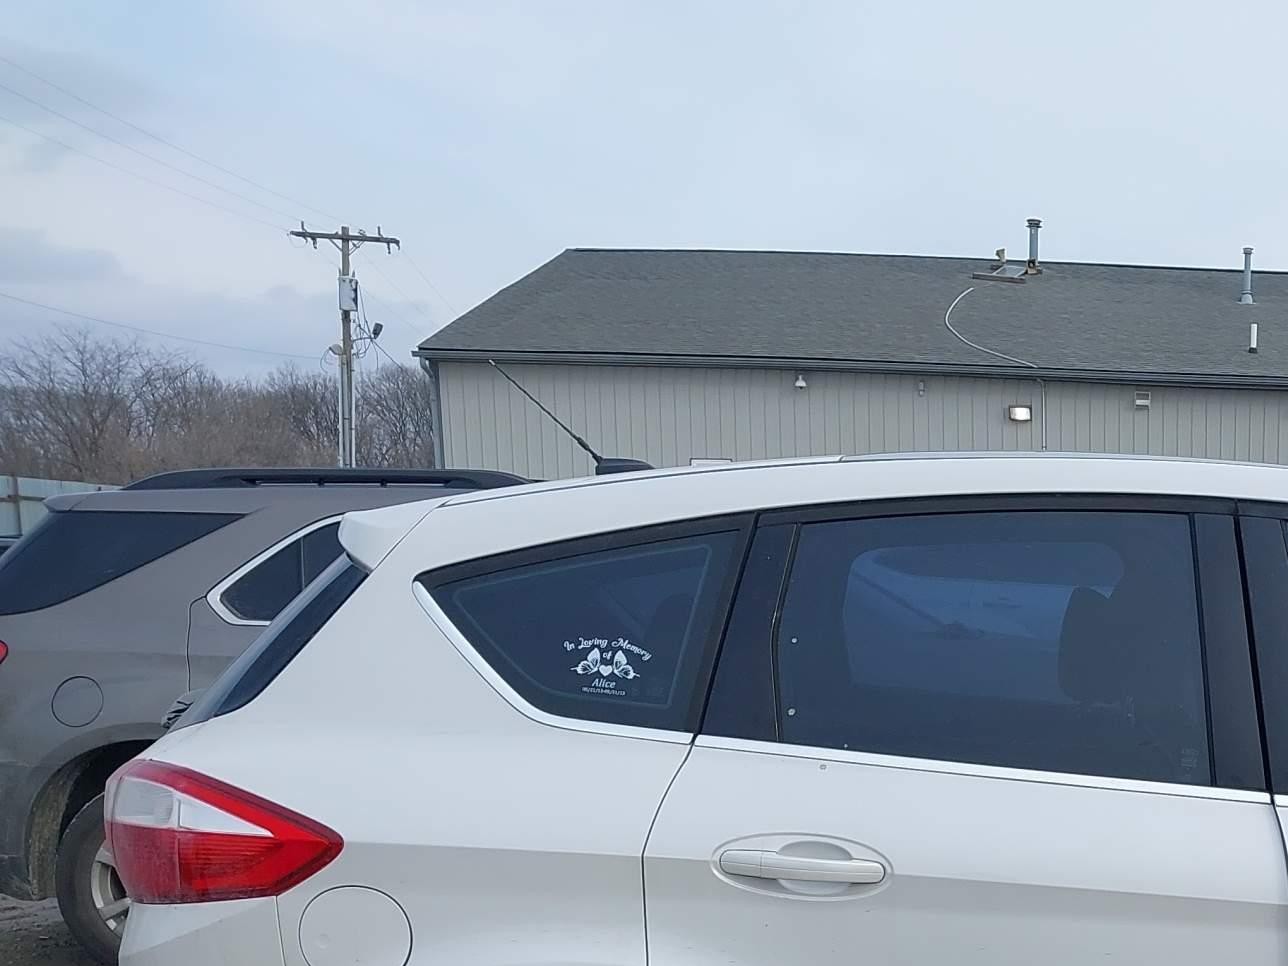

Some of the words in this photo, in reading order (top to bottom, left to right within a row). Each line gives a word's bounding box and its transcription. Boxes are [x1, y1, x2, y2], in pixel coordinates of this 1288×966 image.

[563, 641, 575, 651] In
[578, 637, 608, 649] Loving
[611, 637, 652, 661] Memory
[602, 651, 612, 660] of
[591, 678, 616, 688] Alice
